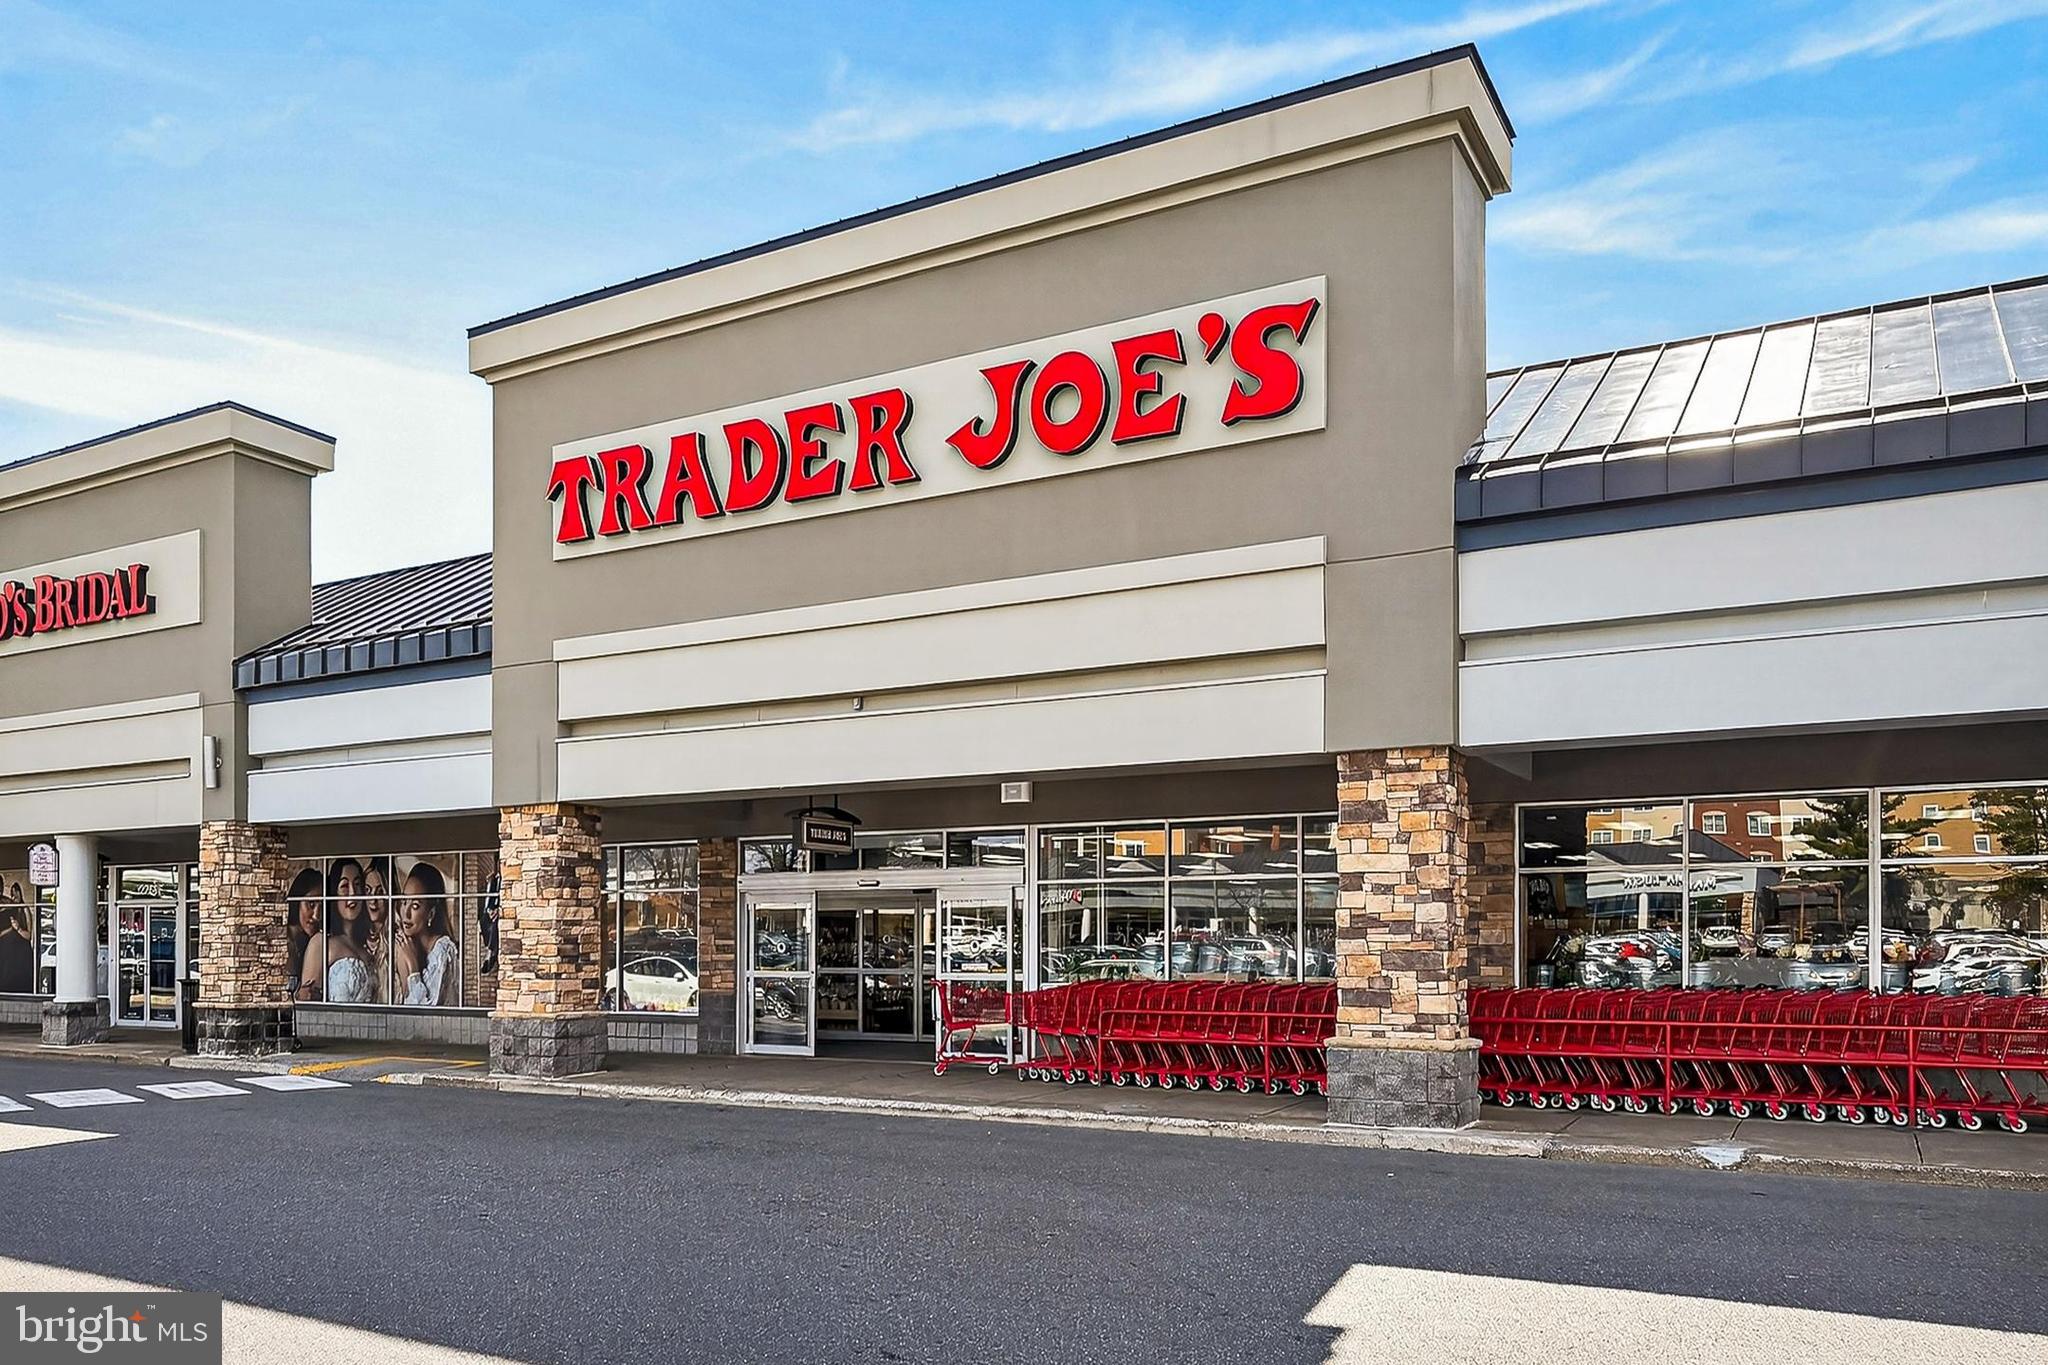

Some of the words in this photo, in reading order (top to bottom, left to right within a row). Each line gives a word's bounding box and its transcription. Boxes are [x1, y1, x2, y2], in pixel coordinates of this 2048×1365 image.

[546, 387, 921, 544] TRADER
[945, 297, 1320, 470] JOE'S
[33, 564, 154, 632] BRIDAL
